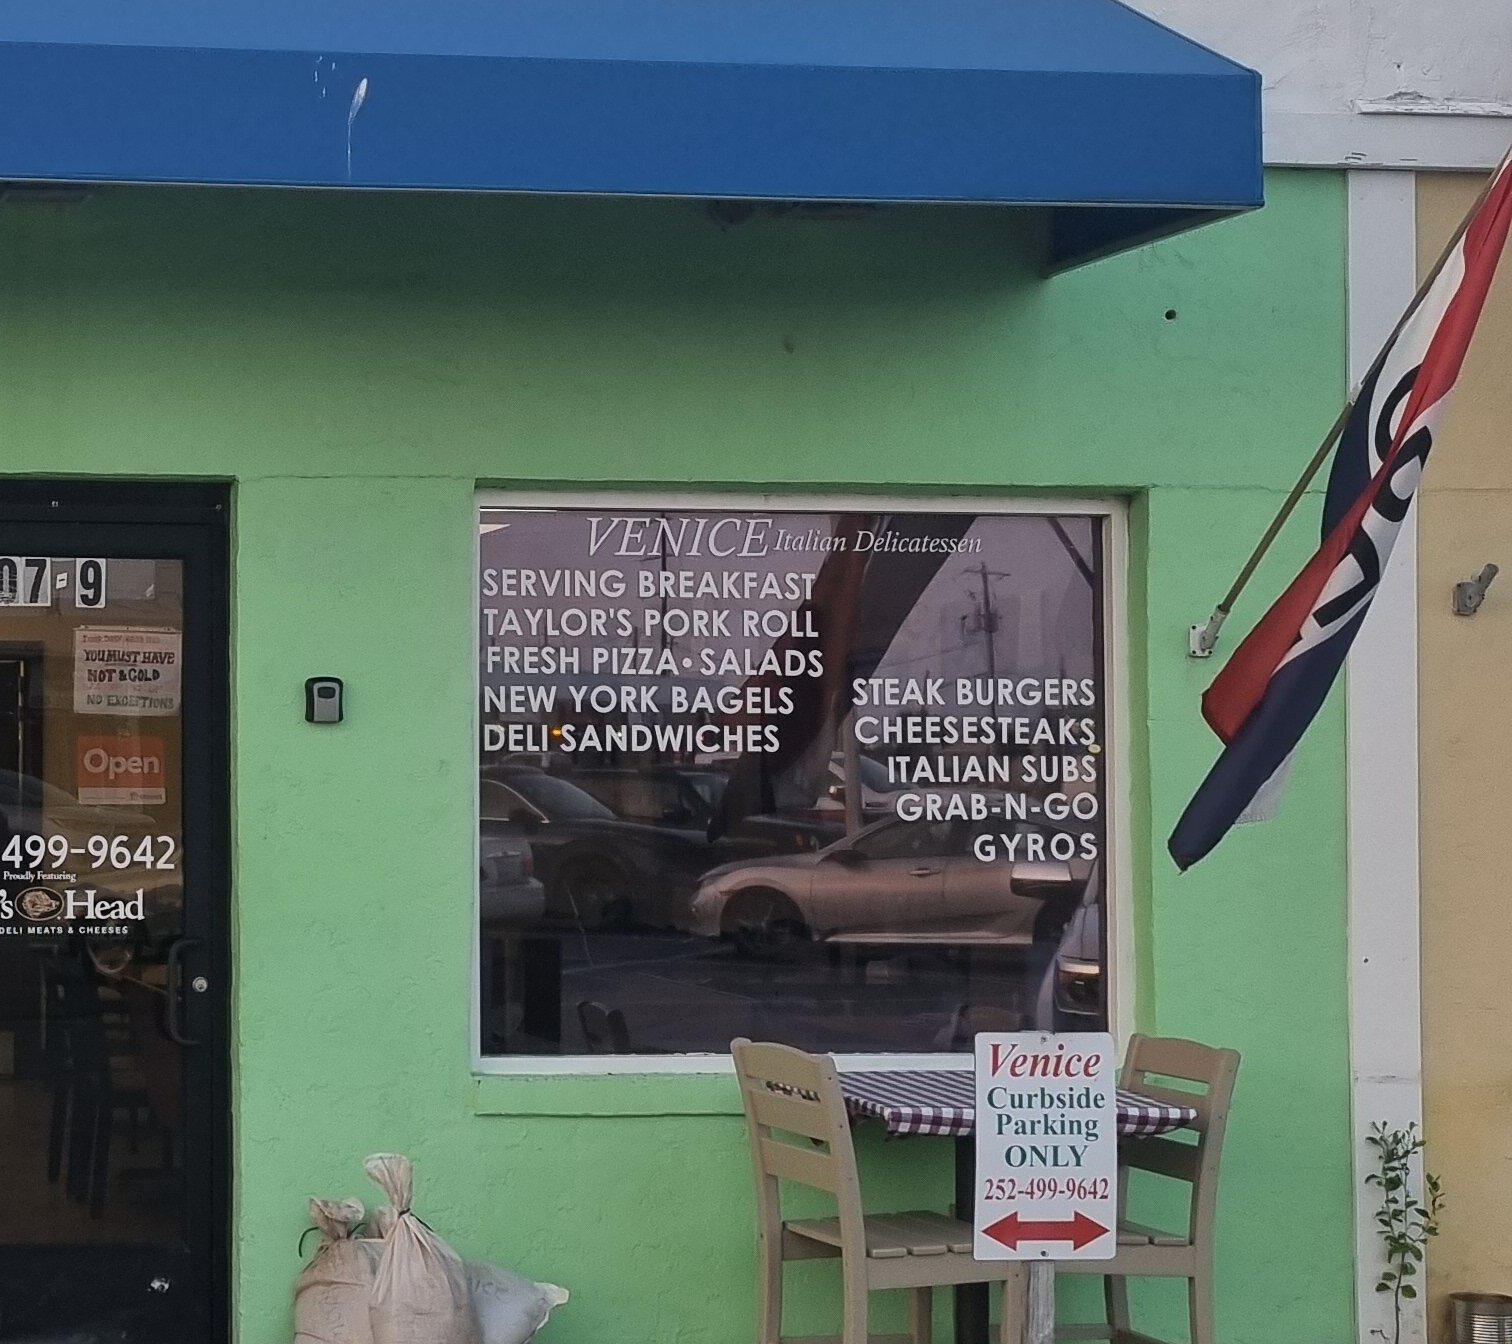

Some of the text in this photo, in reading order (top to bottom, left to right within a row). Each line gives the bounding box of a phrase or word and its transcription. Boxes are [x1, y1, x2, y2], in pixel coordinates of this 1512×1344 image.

[585, 517, 984, 558] VENICE Italian Delicatessen
[482, 569, 816, 601] SERVING BREAKFAST
[483, 608, 819, 638] TAYLOR'S PORK ROLL
[141, 652, 175, 664] HAVE
[486, 646, 580, 675] FRESH
[699, 647, 824, 678] SALADS
[483, 685, 794, 716] NEW YORK BAGELS
[852, 677, 1095, 707] STEAK BURGERS
[483, 723, 780, 754] DELI SANDWICHES
[854, 716, 1096, 746] CHEESESTEAKS
[83, 747, 160, 779] Open
[887, 754, 1096, 784] ITALIAN SUBS
[895, 792, 1099, 822] GRAB-N-GO
[1, 834, 176, 870] 499-9642
[973, 832, 1098, 863] GYROS
[3, 871, 77, 883] Proudly Featuring
[64, 888, 145, 920] Head
[27, 926, 64, 935] MEATS
[79, 925, 128, 935] CHEESES
[989, 1043, 1101, 1078] Venice
[987, 1086, 1106, 1109] Curbside
[996, 1113, 1099, 1141] Parking
[1004, 1144, 1089, 1168] ONLY
[984, 1177, 1109, 1201] 252-499-9642
